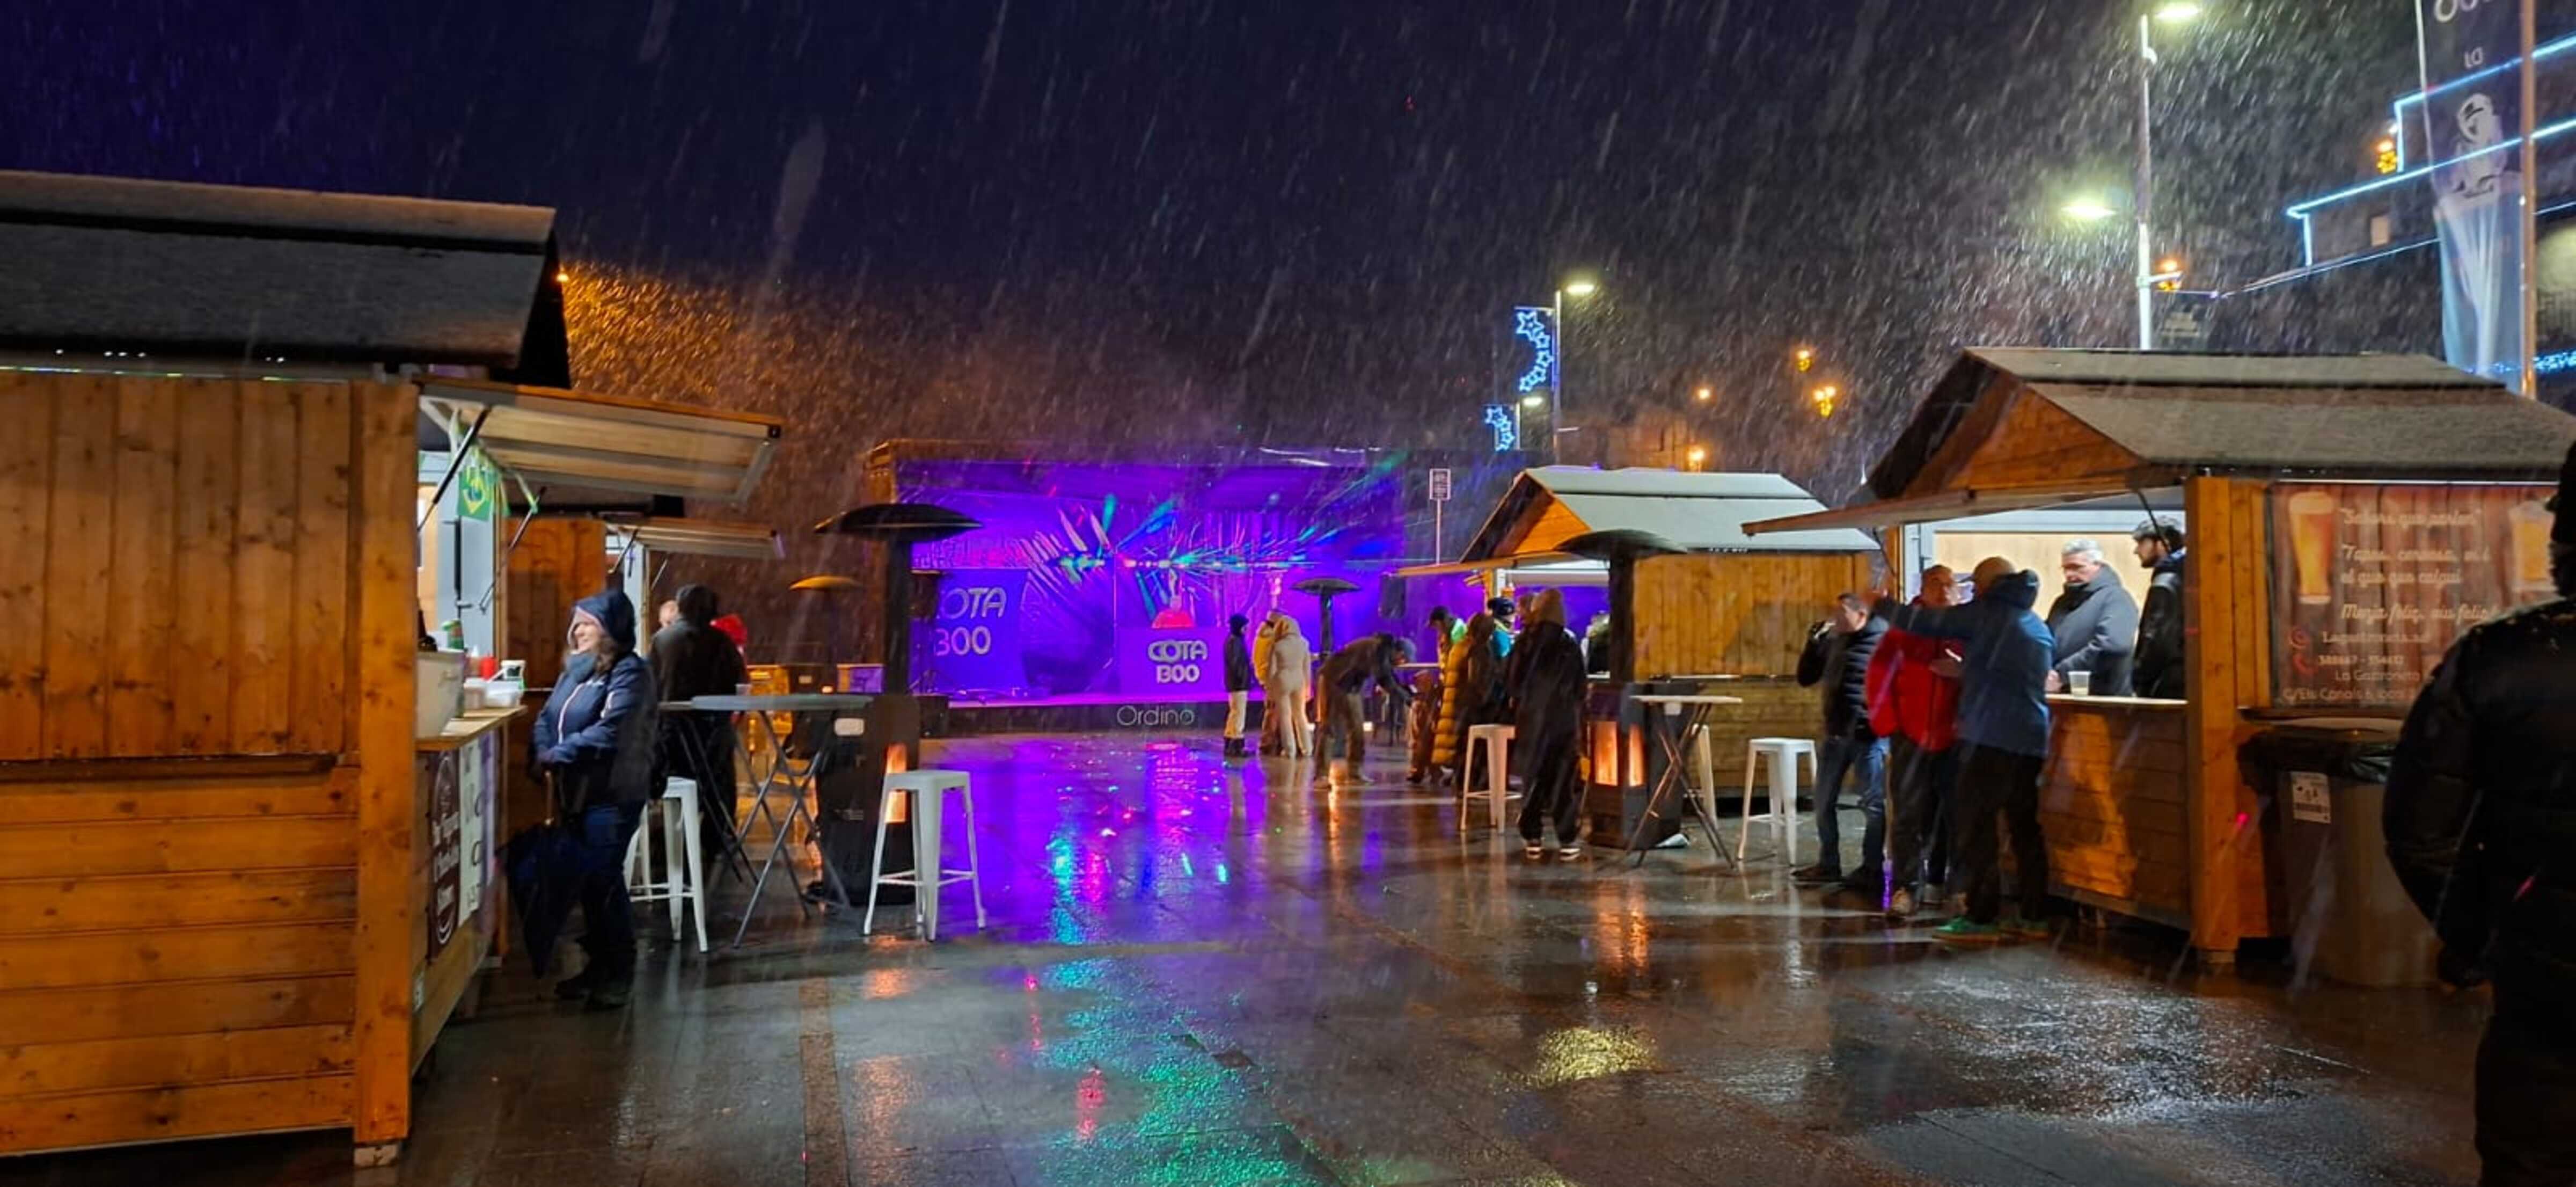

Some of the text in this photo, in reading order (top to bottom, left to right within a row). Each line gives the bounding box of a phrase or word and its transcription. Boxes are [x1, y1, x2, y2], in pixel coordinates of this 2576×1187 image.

[936, 587, 1007, 618] OTA
[1147, 639, 1209, 663] COTA
[1117, 705, 1195, 725] Ordino
